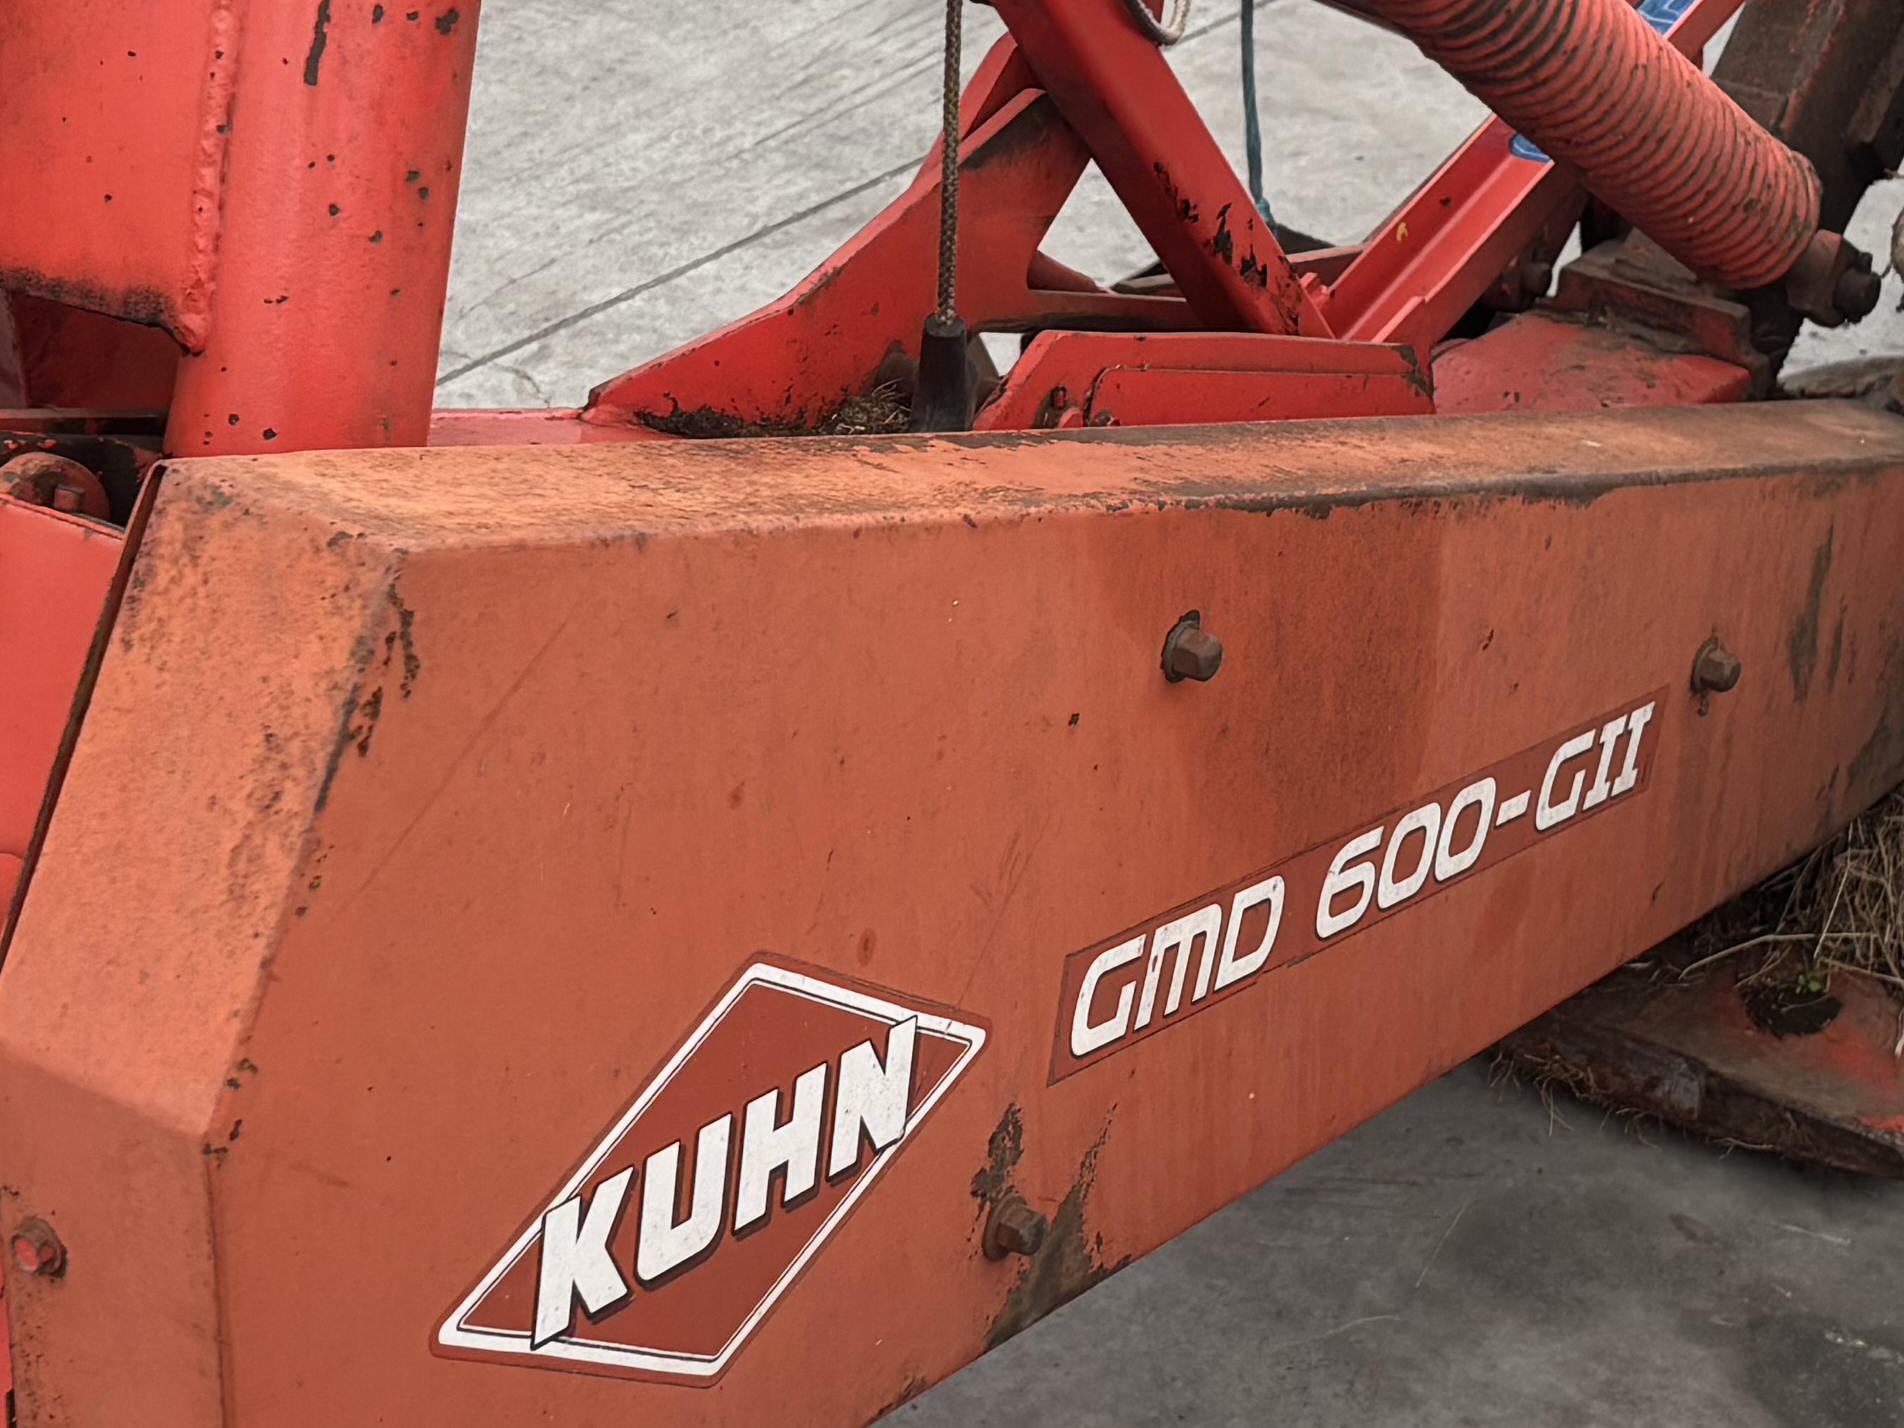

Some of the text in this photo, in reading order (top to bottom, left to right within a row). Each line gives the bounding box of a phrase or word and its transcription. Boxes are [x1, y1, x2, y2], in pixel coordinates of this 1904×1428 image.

[1072, 704, 1652, 1054] GMD 600-GII
[530, 1014, 918, 1349] KUHN
